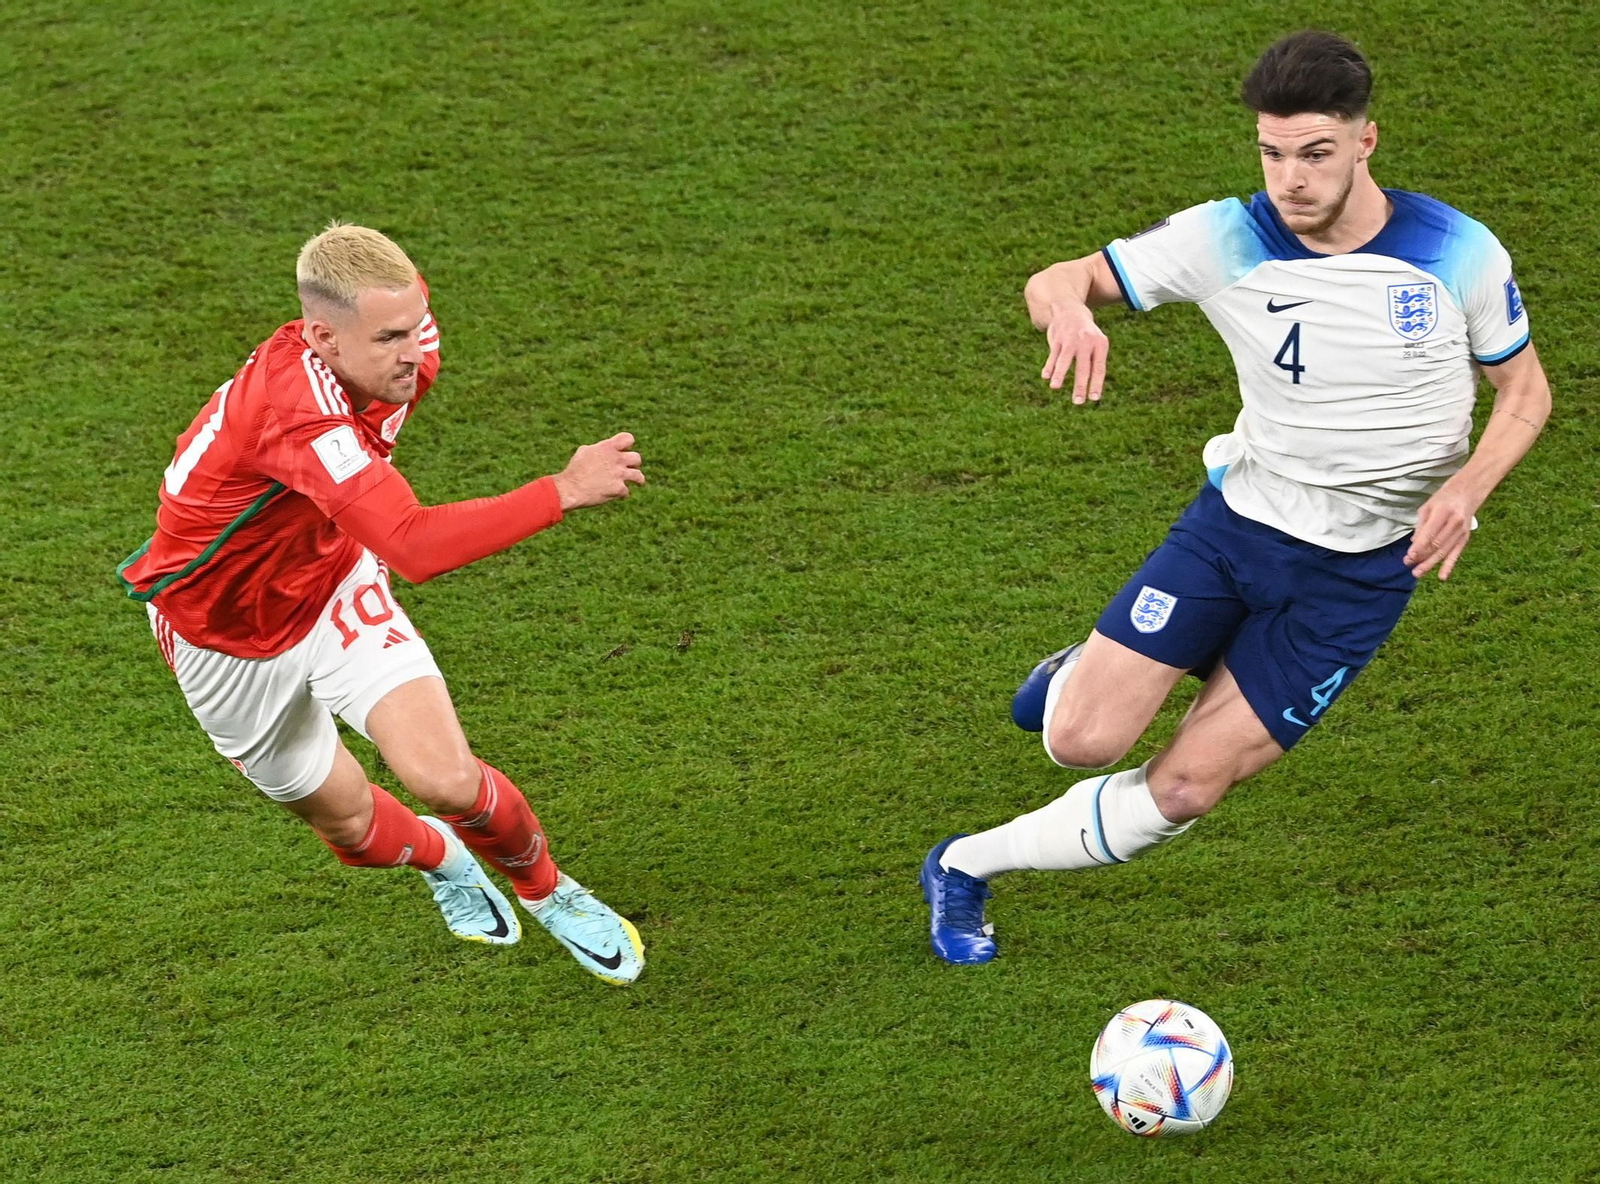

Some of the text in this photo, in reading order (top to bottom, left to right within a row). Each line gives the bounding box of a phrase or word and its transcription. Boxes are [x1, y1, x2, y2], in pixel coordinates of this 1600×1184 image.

[1273, 322, 1305, 384] 4
[330, 582, 393, 650] 10
[1310, 666, 1350, 716] 4
